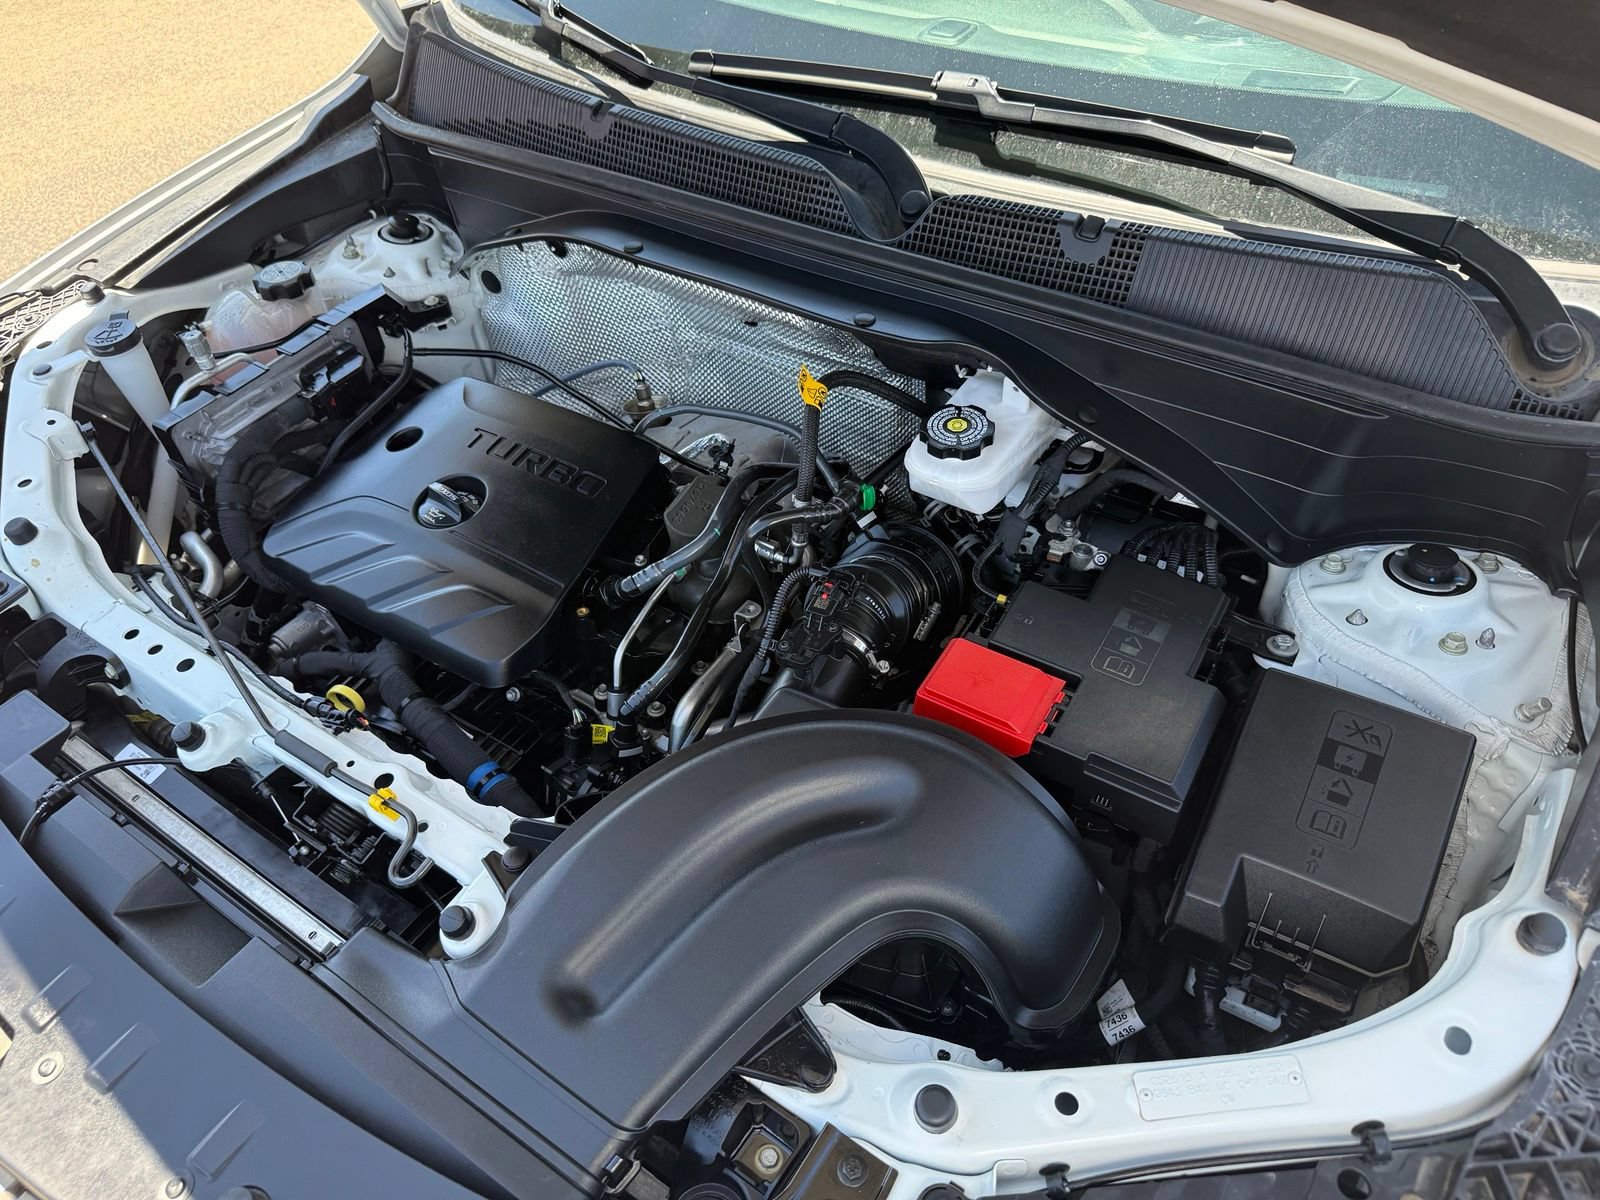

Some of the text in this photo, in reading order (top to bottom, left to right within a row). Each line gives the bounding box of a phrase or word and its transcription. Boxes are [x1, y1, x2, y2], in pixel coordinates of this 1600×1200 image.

[467, 427, 608, 498] TURBO
[1105, 1012, 1128, 1028] 7436
[1111, 1025, 1136, 1041] 7436
